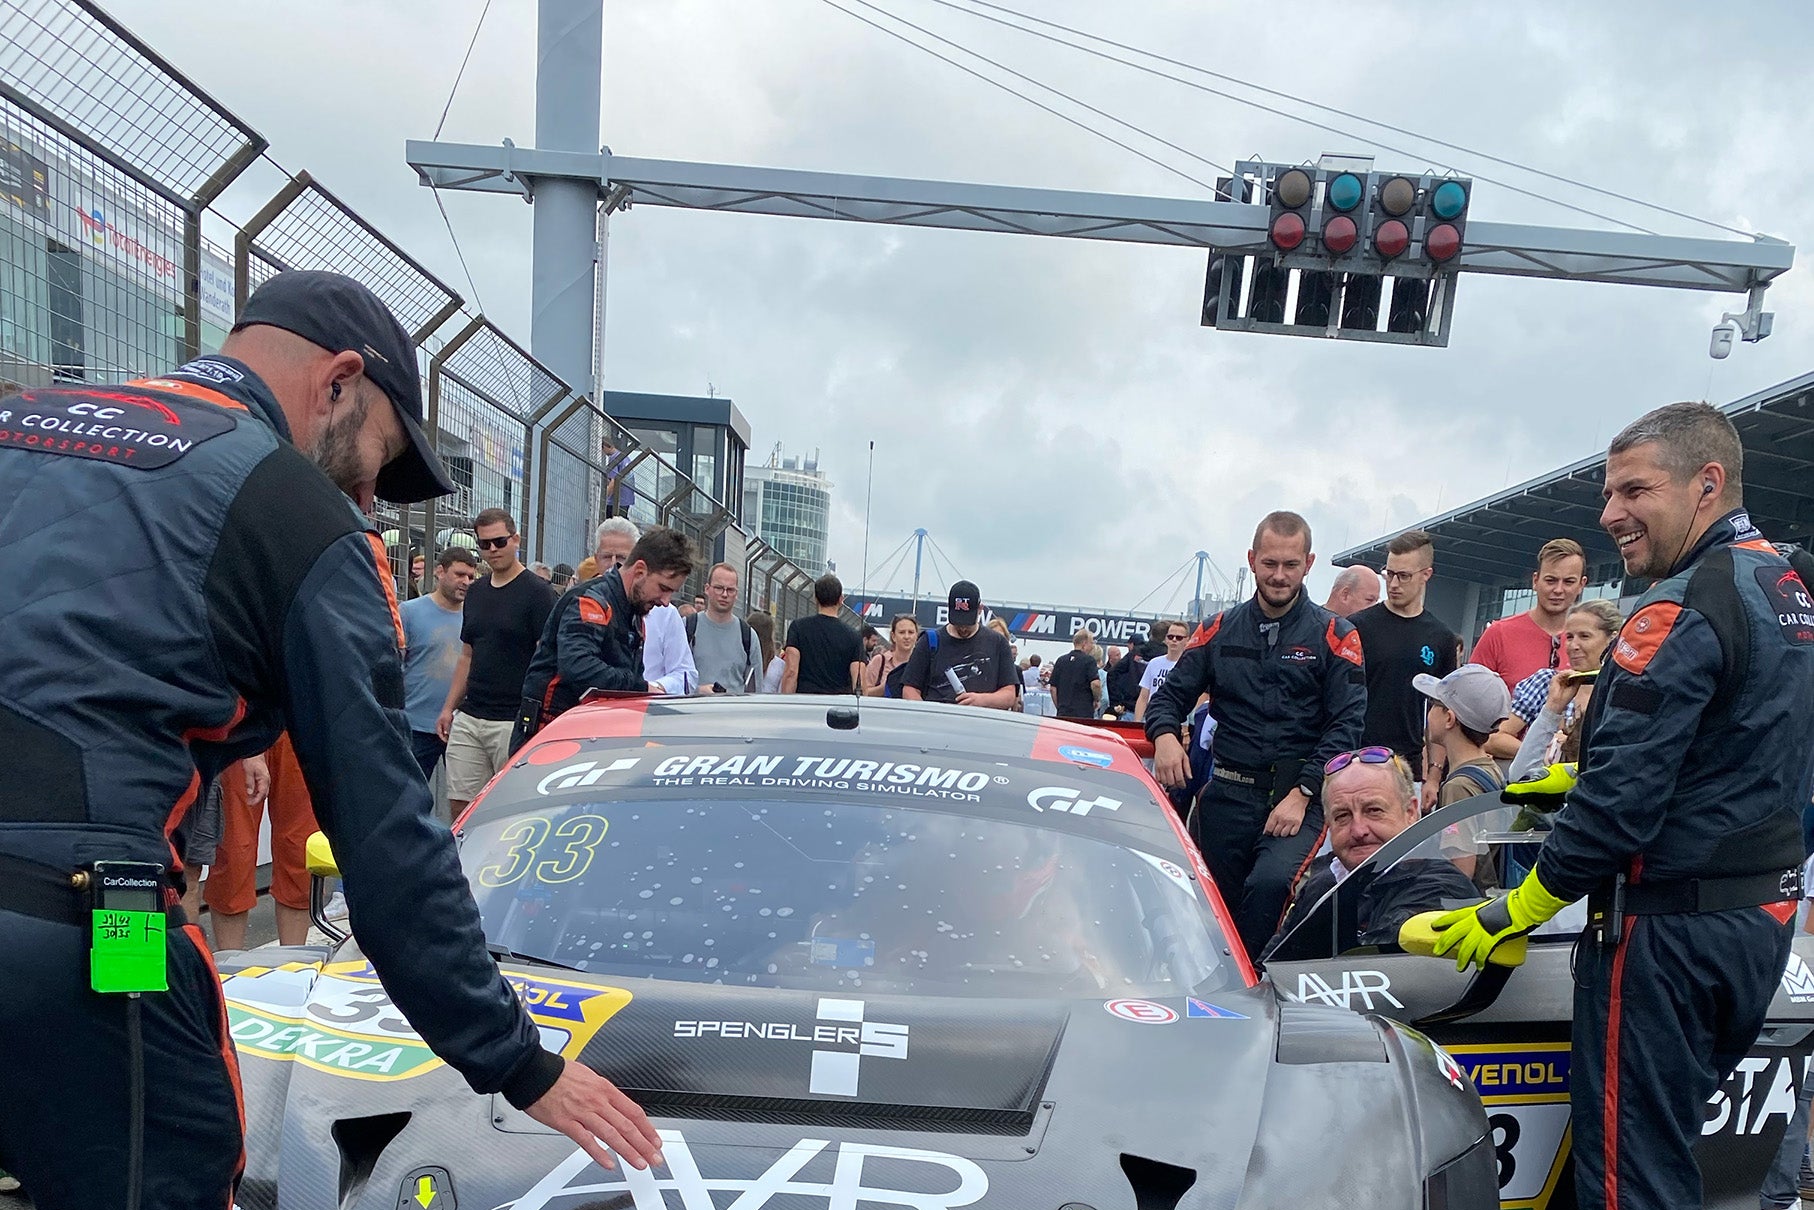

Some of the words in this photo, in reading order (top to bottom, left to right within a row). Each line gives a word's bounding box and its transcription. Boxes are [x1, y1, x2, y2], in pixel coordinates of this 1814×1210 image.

[67, 402, 126, 420] CC
[21, 414, 193, 453] COLLECTION
[1795, 591, 1811, 608] CC
[936, 605, 993, 627] BW
[1027, 613, 1056, 634] M
[1069, 616, 1151, 642] POWER
[1779, 613, 1797, 626] CAR
[652, 755, 786, 777] GRAN
[652, 777, 694, 786] THE
[700, 776, 756, 786] REAL
[761, 777, 849, 790] DRIVING
[855, 782, 981, 803] SIMULATOR
[478, 814, 609, 888] 33
[103, 876, 158, 888] CarCollection
[1297, 970, 1405, 1010] AVR
[232, 1017, 403, 1074] DEKRA
[673, 1020, 910, 1060] SPENGLERS
